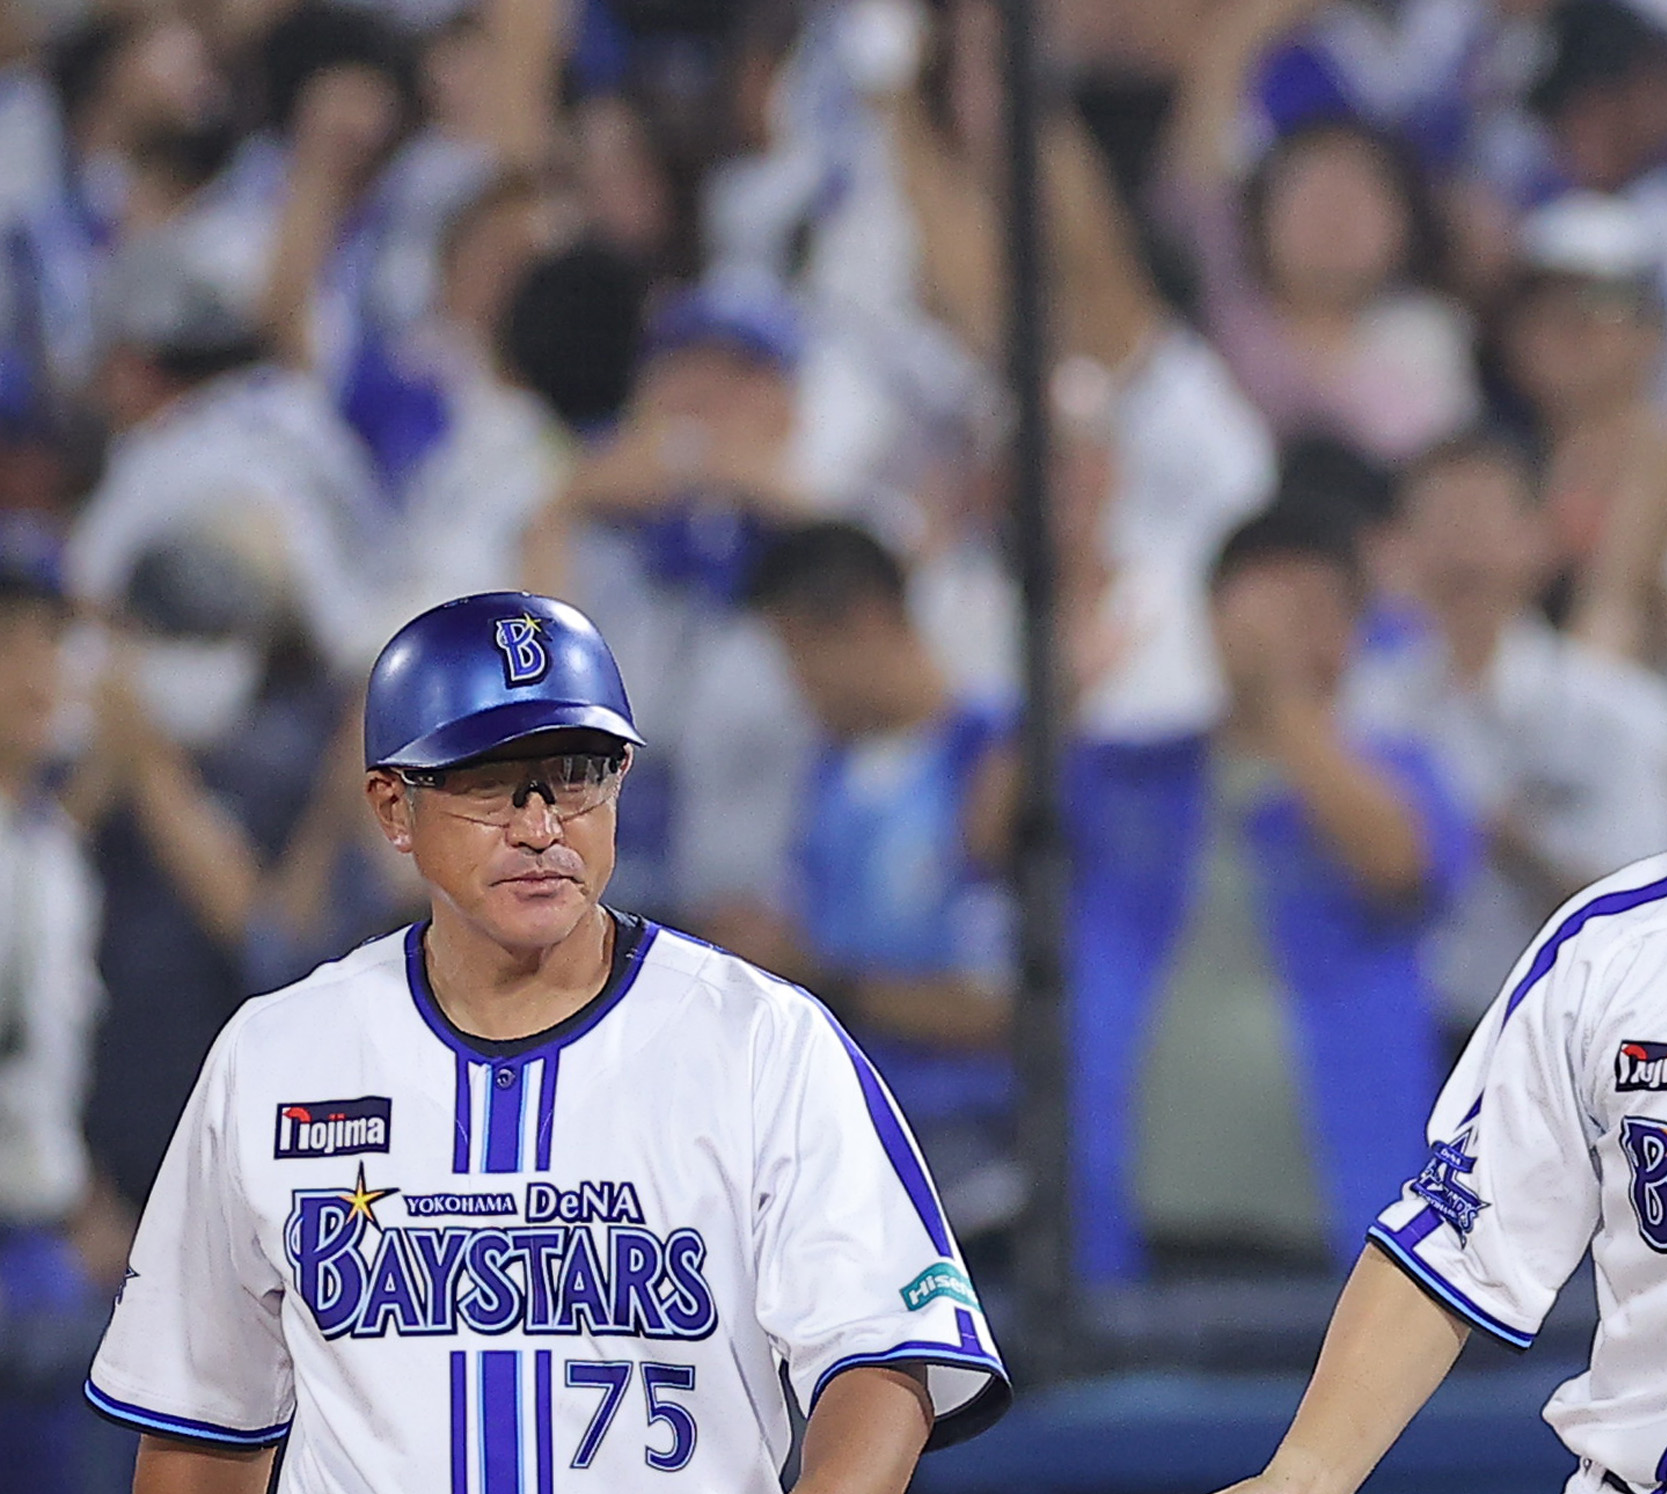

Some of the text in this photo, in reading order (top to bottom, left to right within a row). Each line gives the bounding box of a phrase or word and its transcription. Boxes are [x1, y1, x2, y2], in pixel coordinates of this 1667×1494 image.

[494, 616, 550, 688] B
[280, 1106, 386, 1154] nojima
[403, 1181, 645, 1224] YOKOHAMA DeNA
[283, 1188, 719, 1342] BAYSTARS
[563, 1359, 698, 1473] 75
